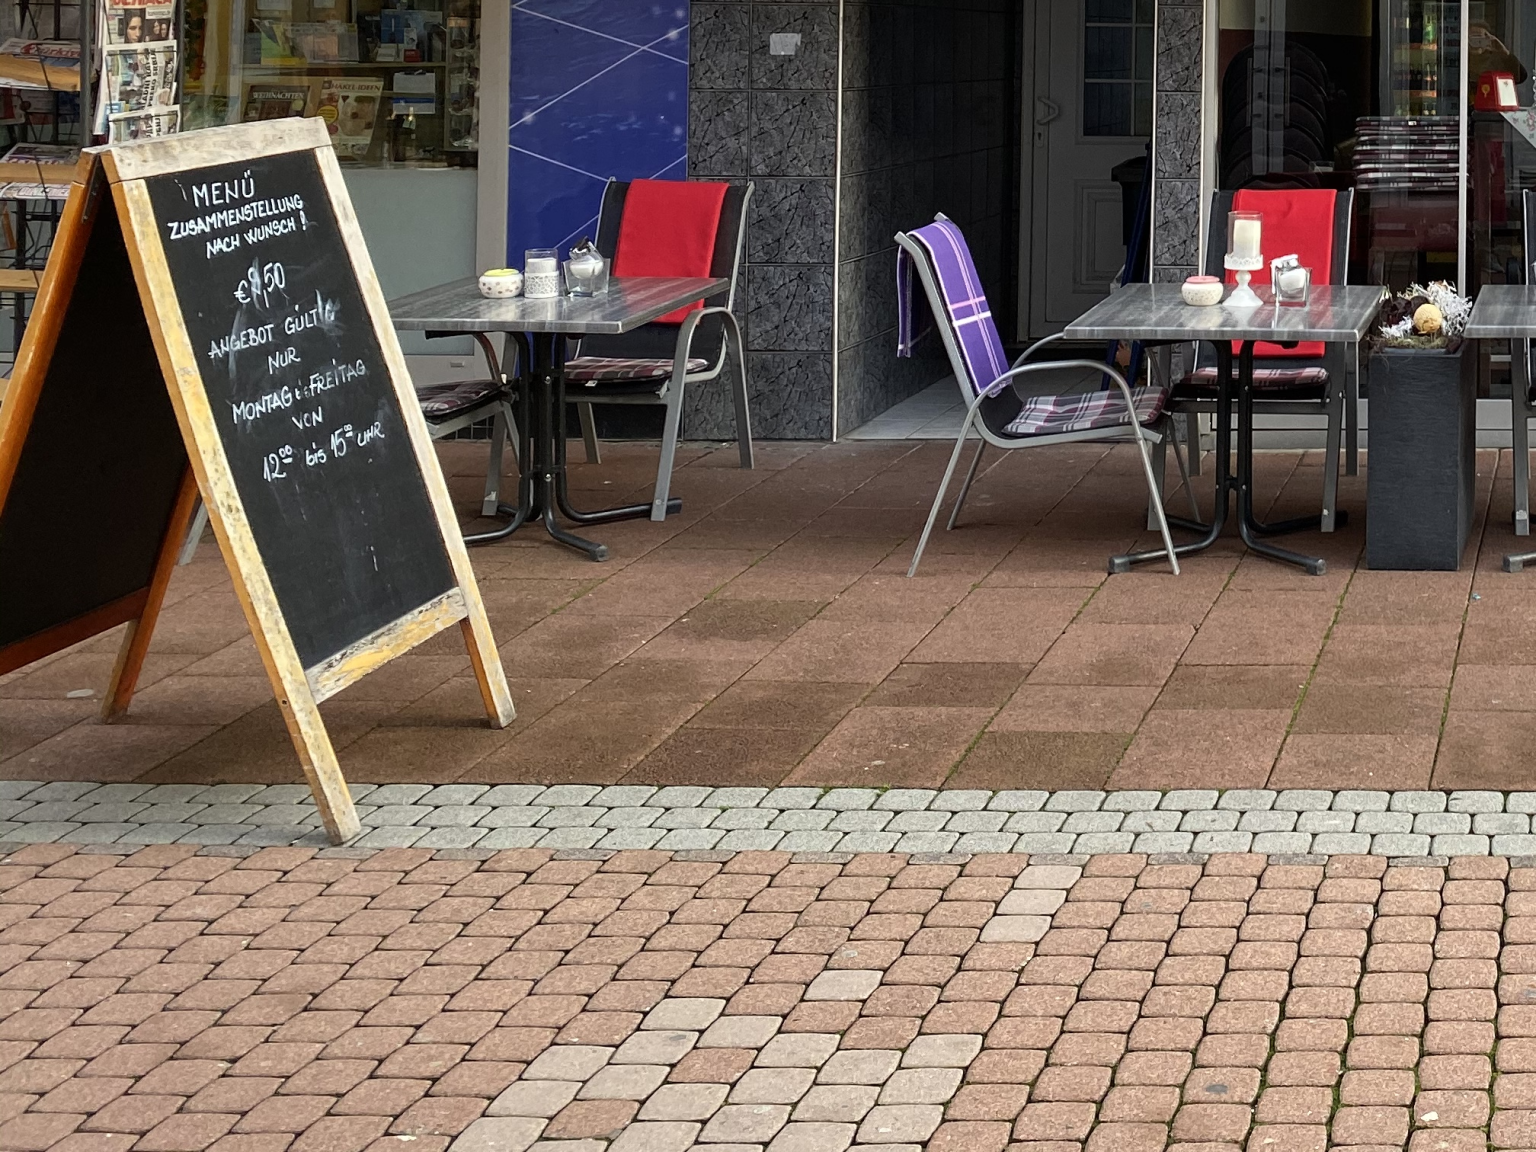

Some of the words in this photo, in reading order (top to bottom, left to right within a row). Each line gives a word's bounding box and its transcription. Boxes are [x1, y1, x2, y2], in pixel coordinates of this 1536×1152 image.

[192, 170, 255, 208] MENÜ
[167, 193, 304, 240] ZUSAMMENSTELLUNG
[206, 232, 241, 260] NACH
[244, 216, 296, 245] WUNSCH
[208, 324, 274, 359] ANGEBOT
[268, 347, 301, 375] NUR
[232, 386, 293, 424] MONTAG
[308, 358, 367, 397] FREITAG
[292, 406, 323, 431] VON
[305, 441, 327, 466] bis
[357, 421, 385, 448] UHR
